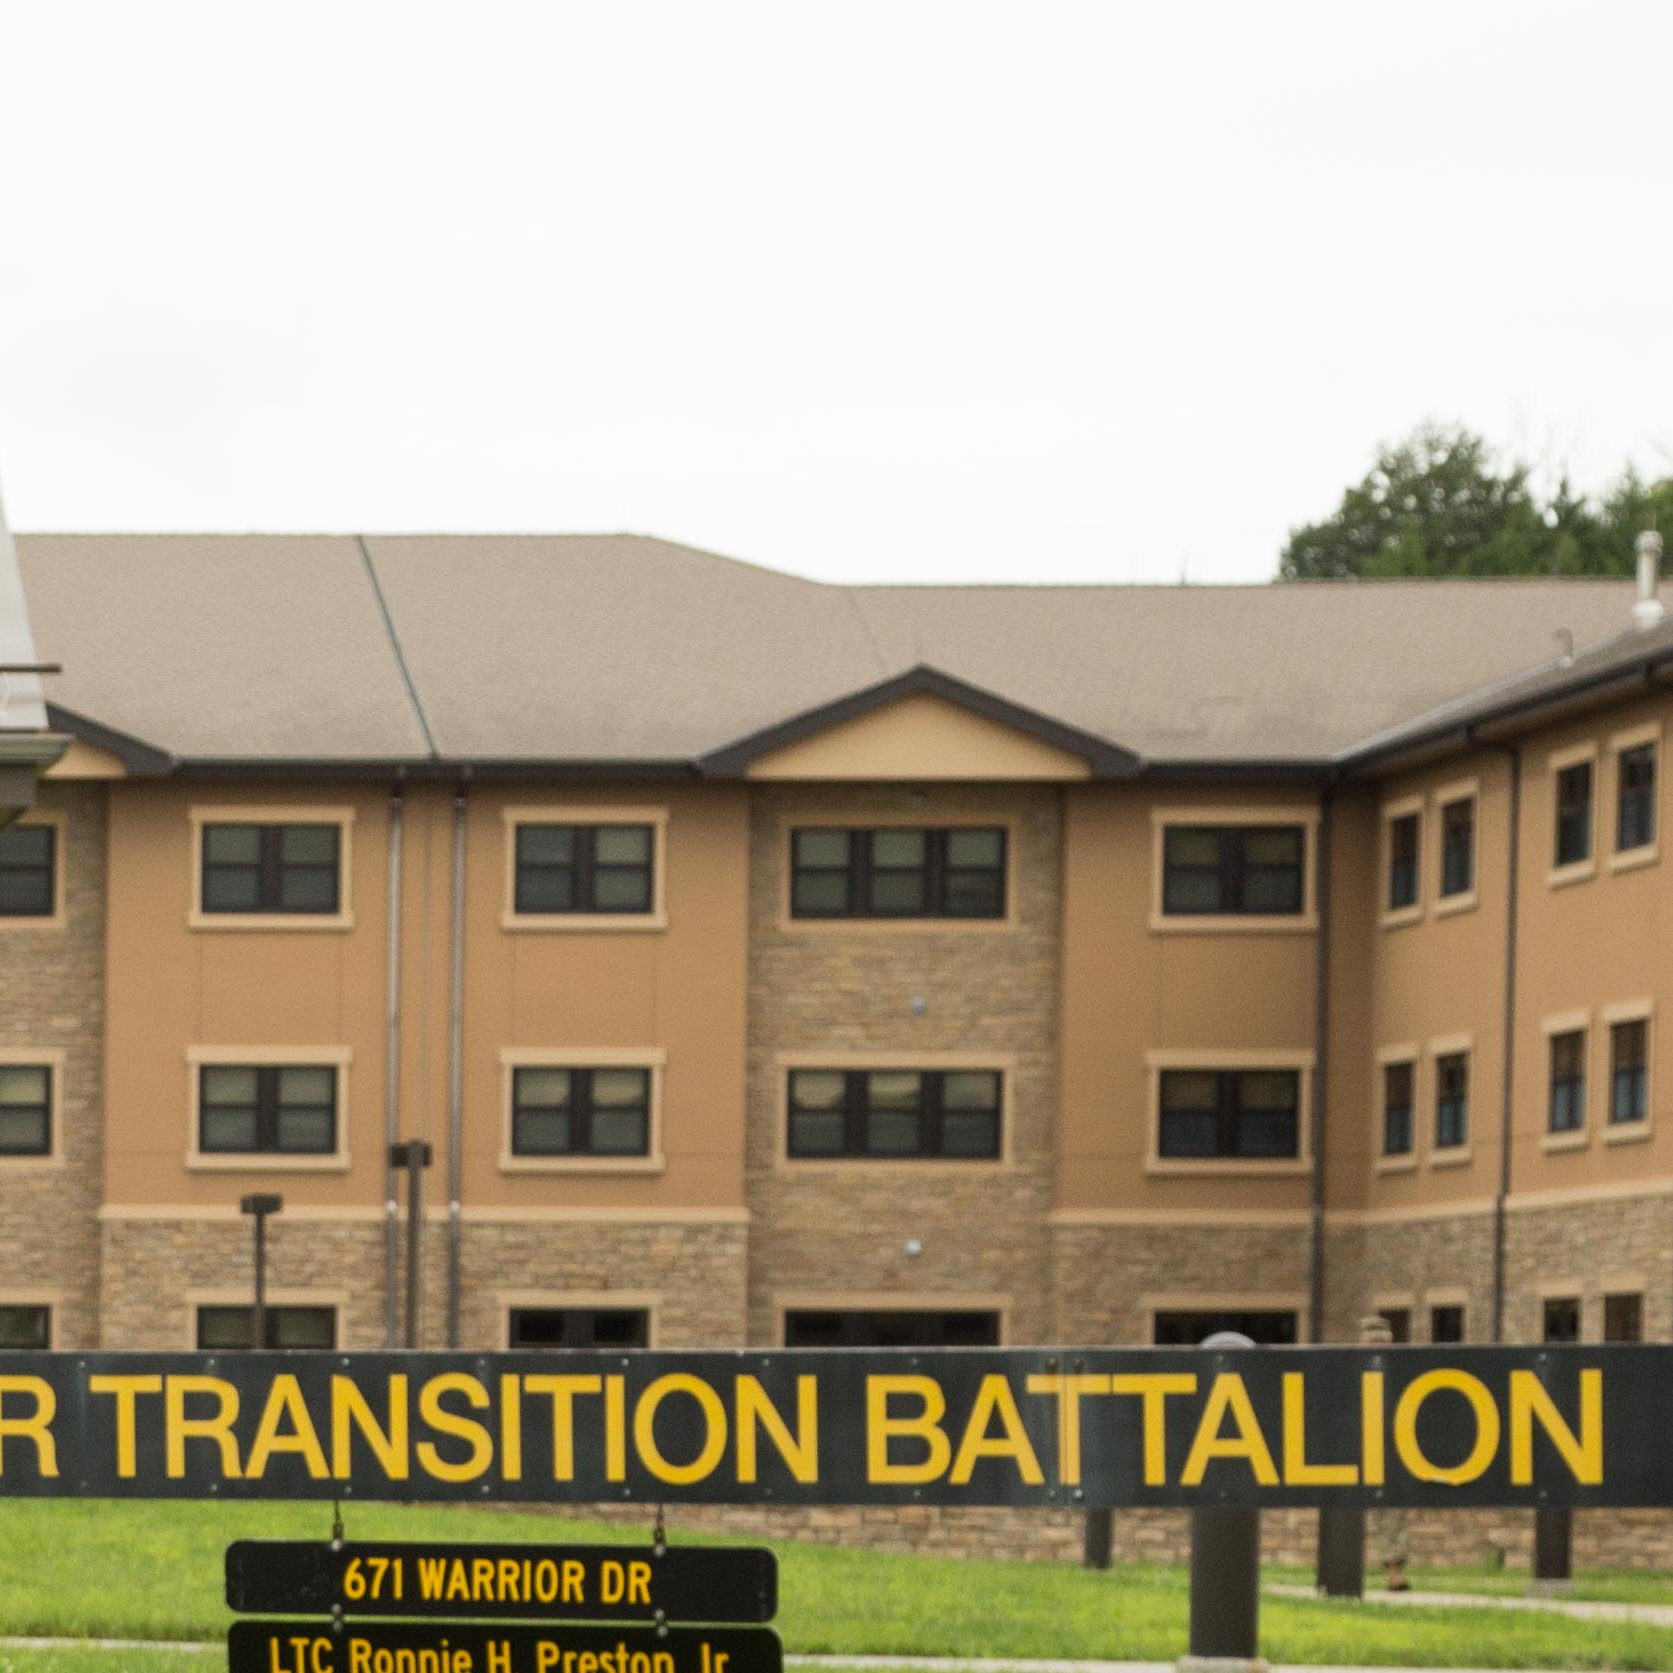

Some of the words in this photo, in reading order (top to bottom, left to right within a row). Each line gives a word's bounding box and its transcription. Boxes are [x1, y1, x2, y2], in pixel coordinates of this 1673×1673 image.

[89, 1372, 819, 1484] TRANSITION
[866, 1368, 1604, 1487] BATTALION
[343, 1557, 403, 1600] 671
[418, 1558, 586, 1603] WARRIOR
[601, 1560, 652, 1604] DR
